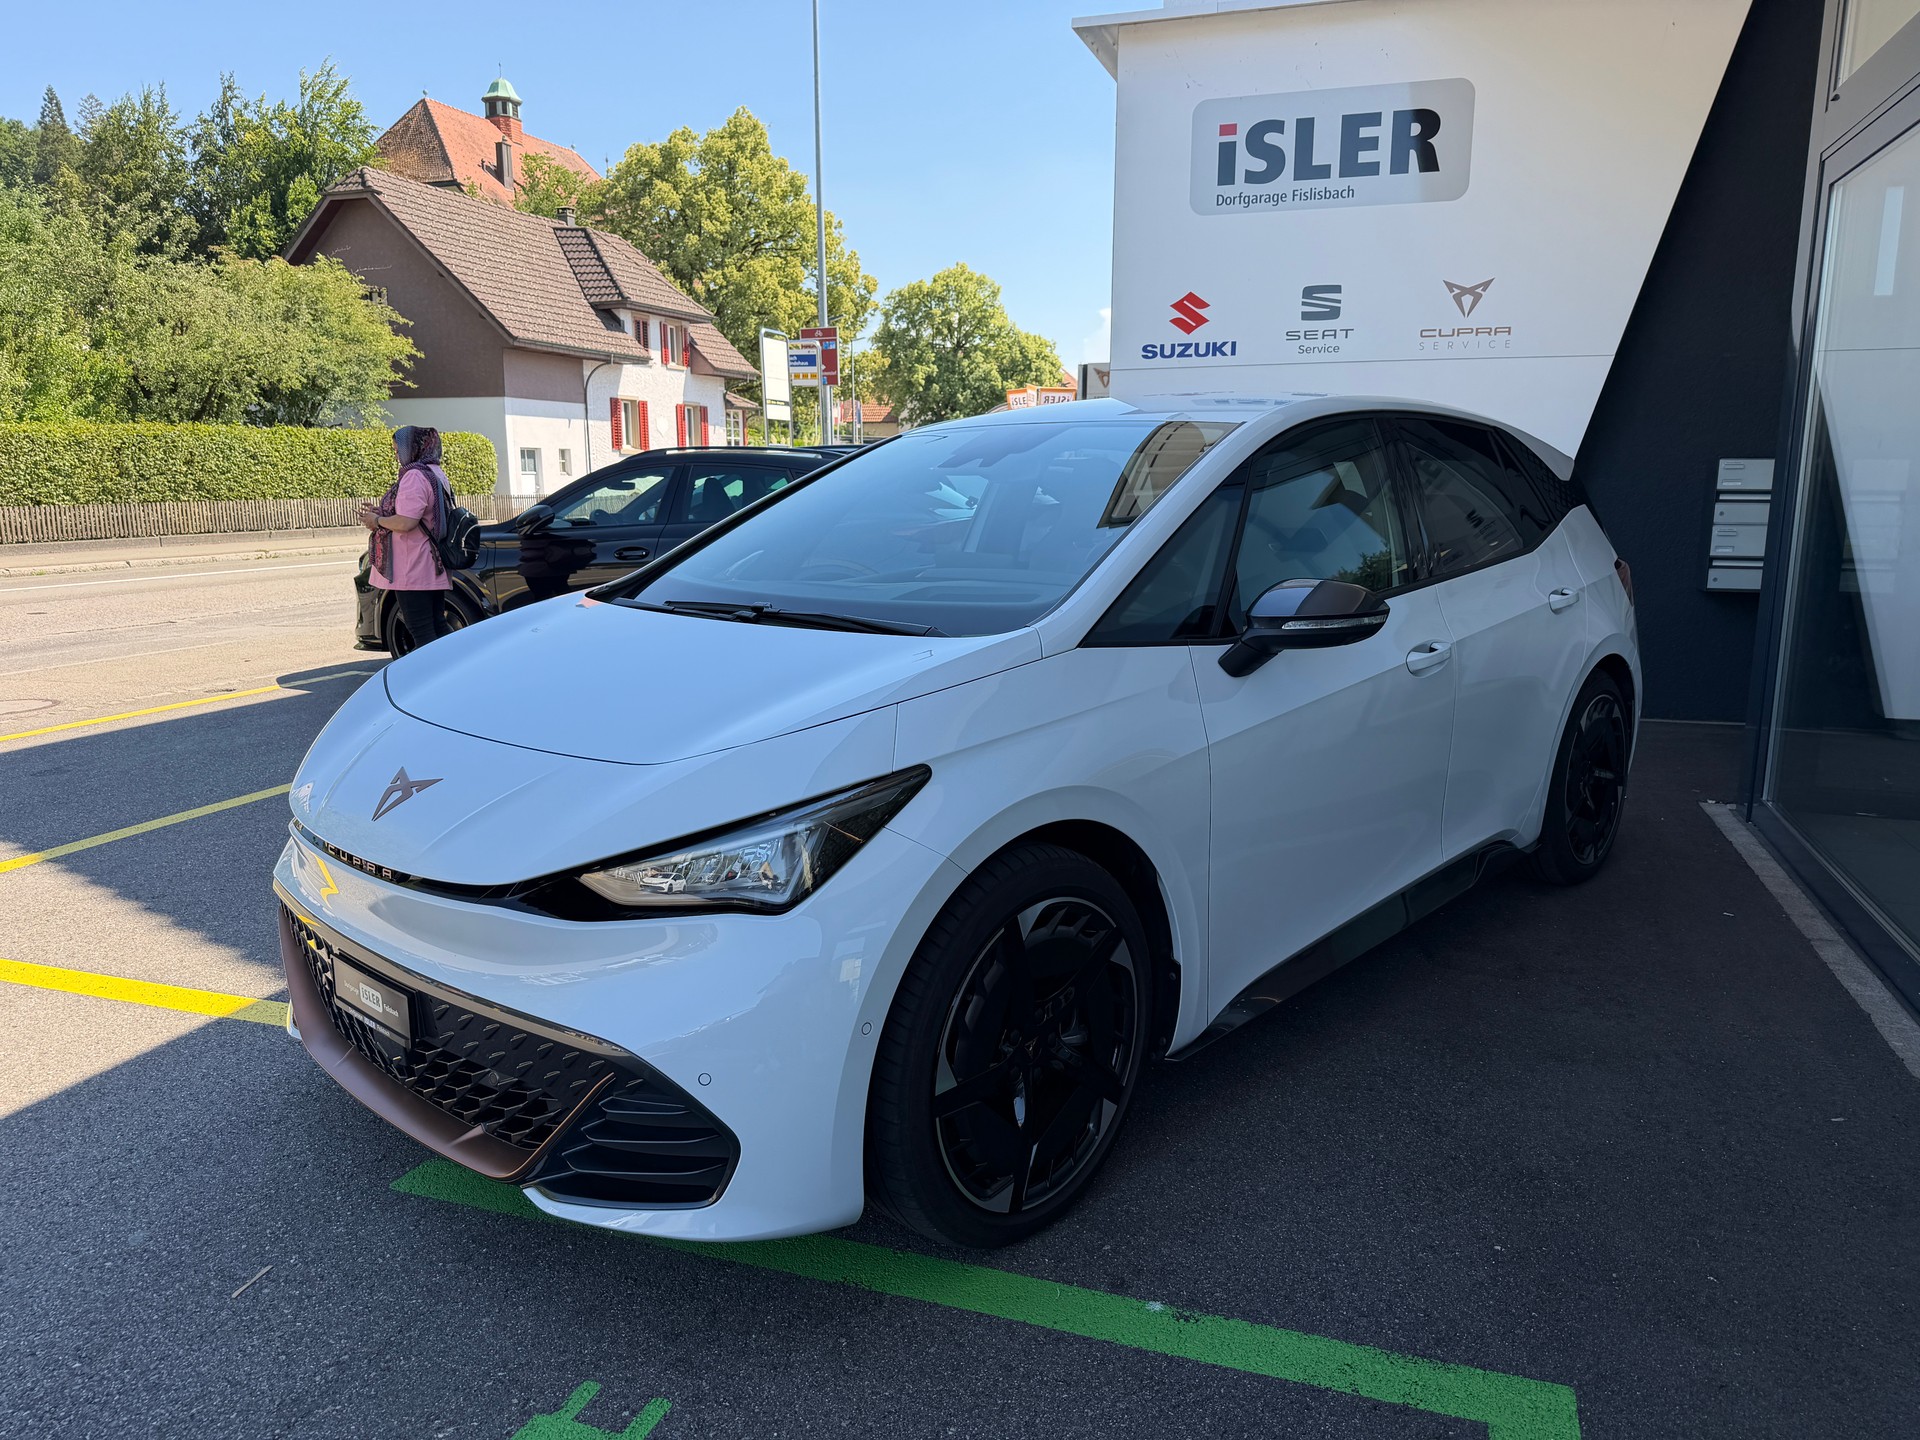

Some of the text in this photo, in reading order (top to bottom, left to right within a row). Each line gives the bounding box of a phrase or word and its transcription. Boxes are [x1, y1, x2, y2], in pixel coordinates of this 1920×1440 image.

[1217, 108, 1441, 186] iSLER
[1216, 185, 1355, 209] Dorfgarage Fislisbach
[1285, 328, 1355, 341] SEAT
[1420, 326, 1512, 338] CUPRA
[1141, 340, 1237, 360] SUZUKI
[1297, 343, 1341, 354] Service
[1419, 339, 1512, 351] SERVICE
[327, 844, 392, 880] CUPRA
